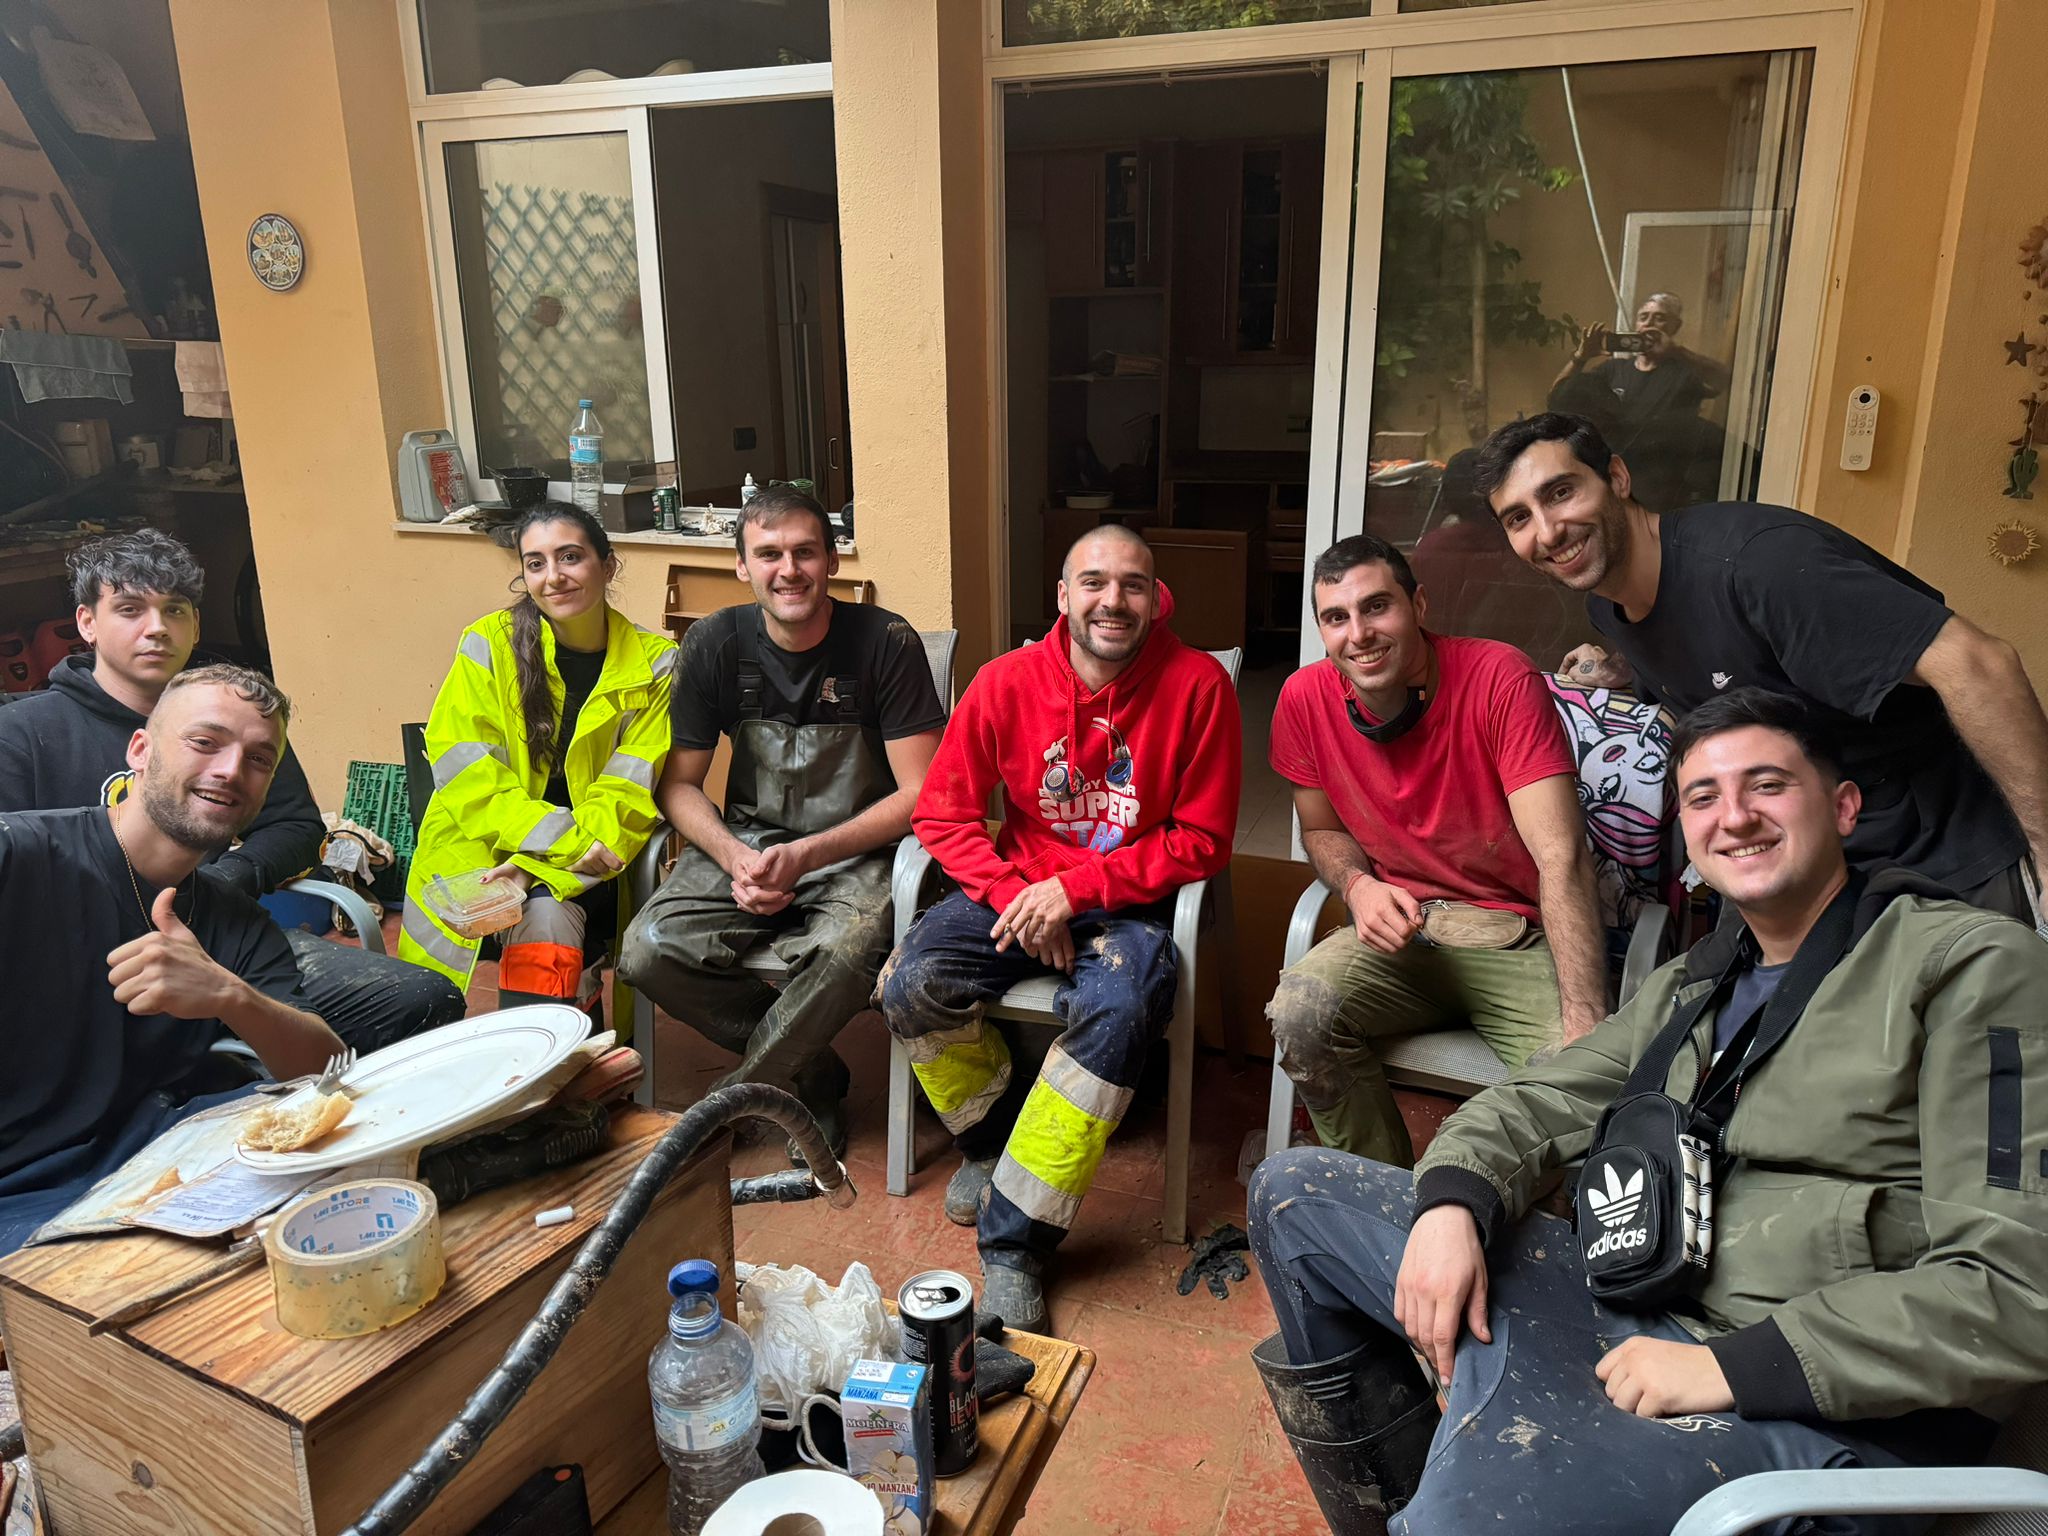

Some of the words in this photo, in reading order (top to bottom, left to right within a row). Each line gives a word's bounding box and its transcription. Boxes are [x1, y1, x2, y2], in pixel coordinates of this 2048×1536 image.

[1038, 791, 1140, 828] SUPER
[331, 1196, 370, 1212] STORE
[1587, 1227, 1648, 1260] adidas
[845, 1387, 879, 1400] MANZANA
[949, 1384, 978, 1413] BLAC
[878, 1483, 917, 1496] MANZANA
